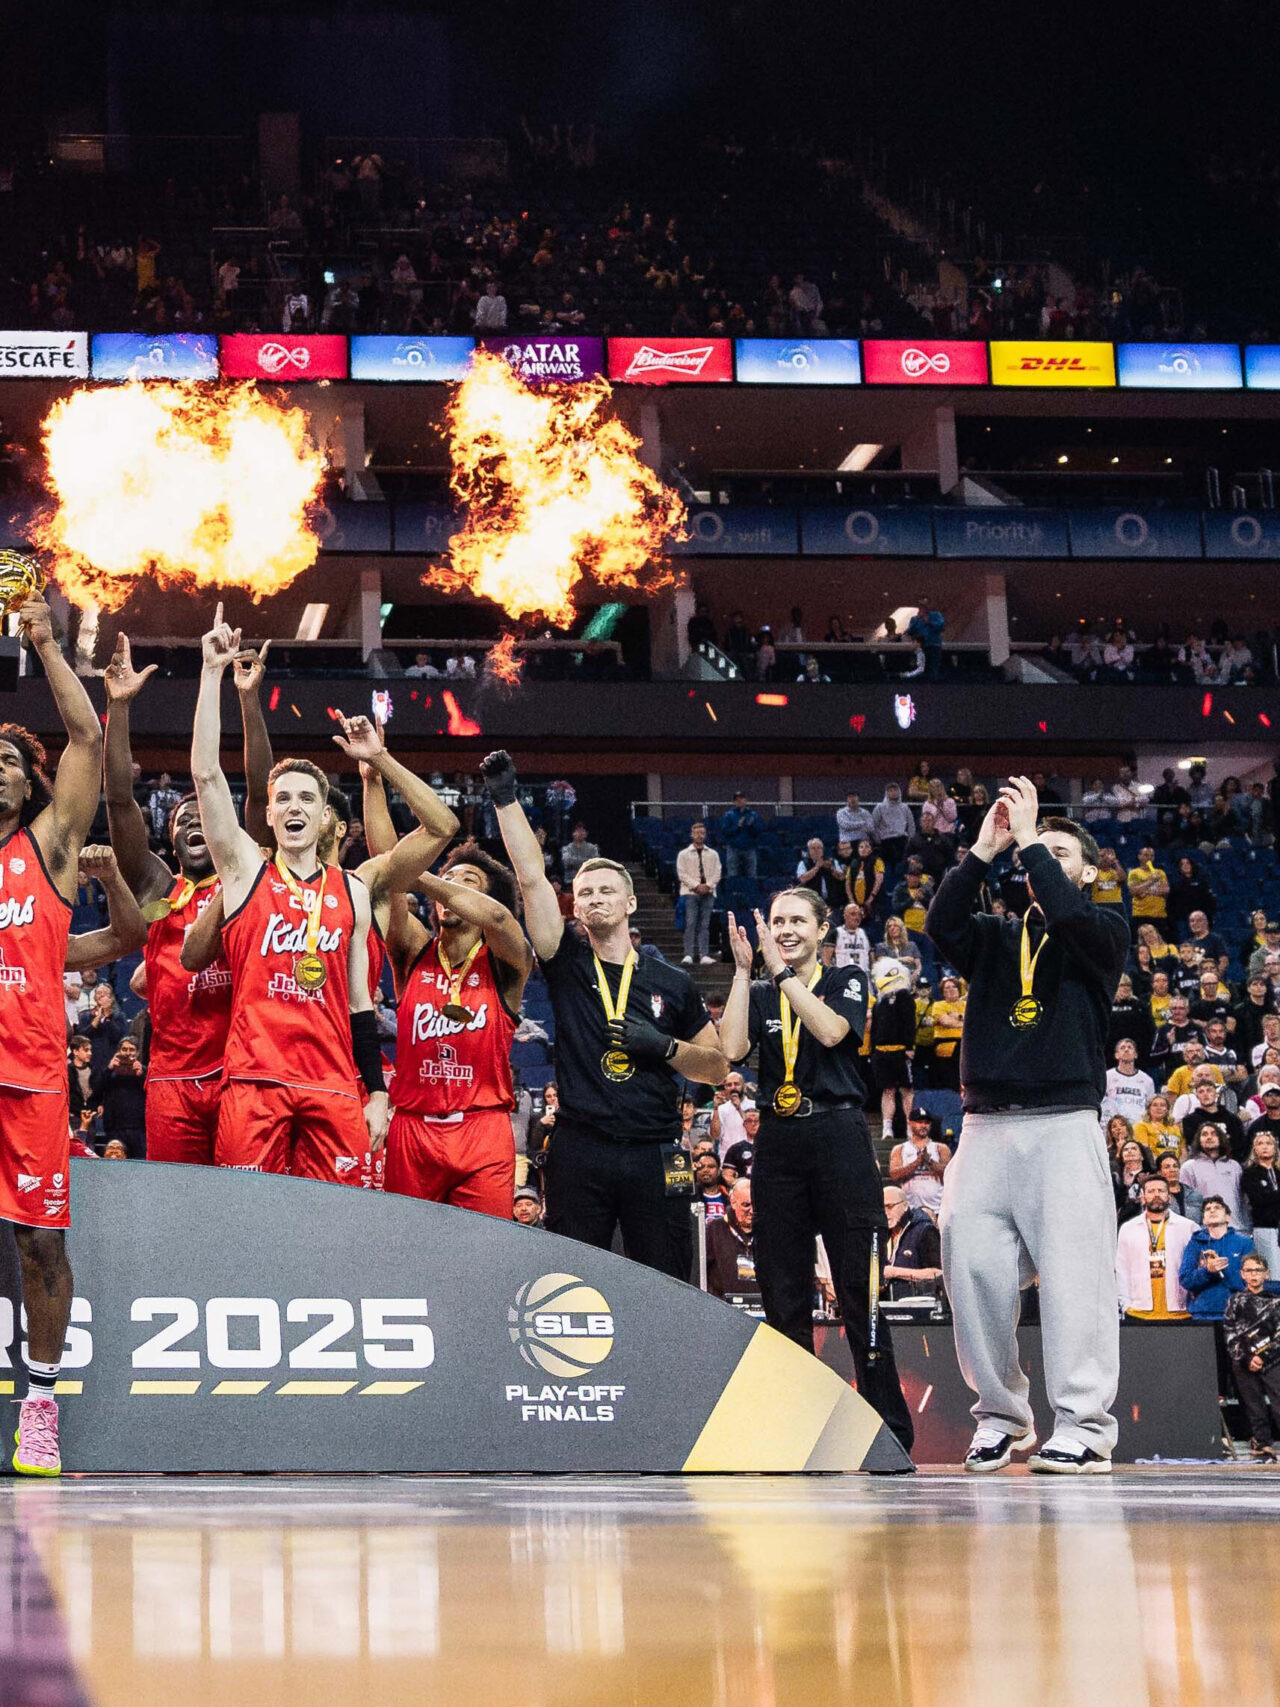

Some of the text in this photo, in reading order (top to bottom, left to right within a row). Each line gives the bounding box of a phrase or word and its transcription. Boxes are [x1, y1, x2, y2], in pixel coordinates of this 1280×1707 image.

[639, 353, 706, 367] Budweiser
[1020, 358, 1086, 370] DHL
[966, 519, 1040, 546] Priority
[260, 913, 342, 957] Ridrs
[420, 1060, 473, 1079] Jelson
[669, 1176, 690, 1184] TEAM
[130, 1297, 435, 1369] 2025
[535, 1315, 615, 1336] SLB
[505, 1385, 626, 1401] PLAY-OFF
[522, 1405, 615, 1422] FINALS
